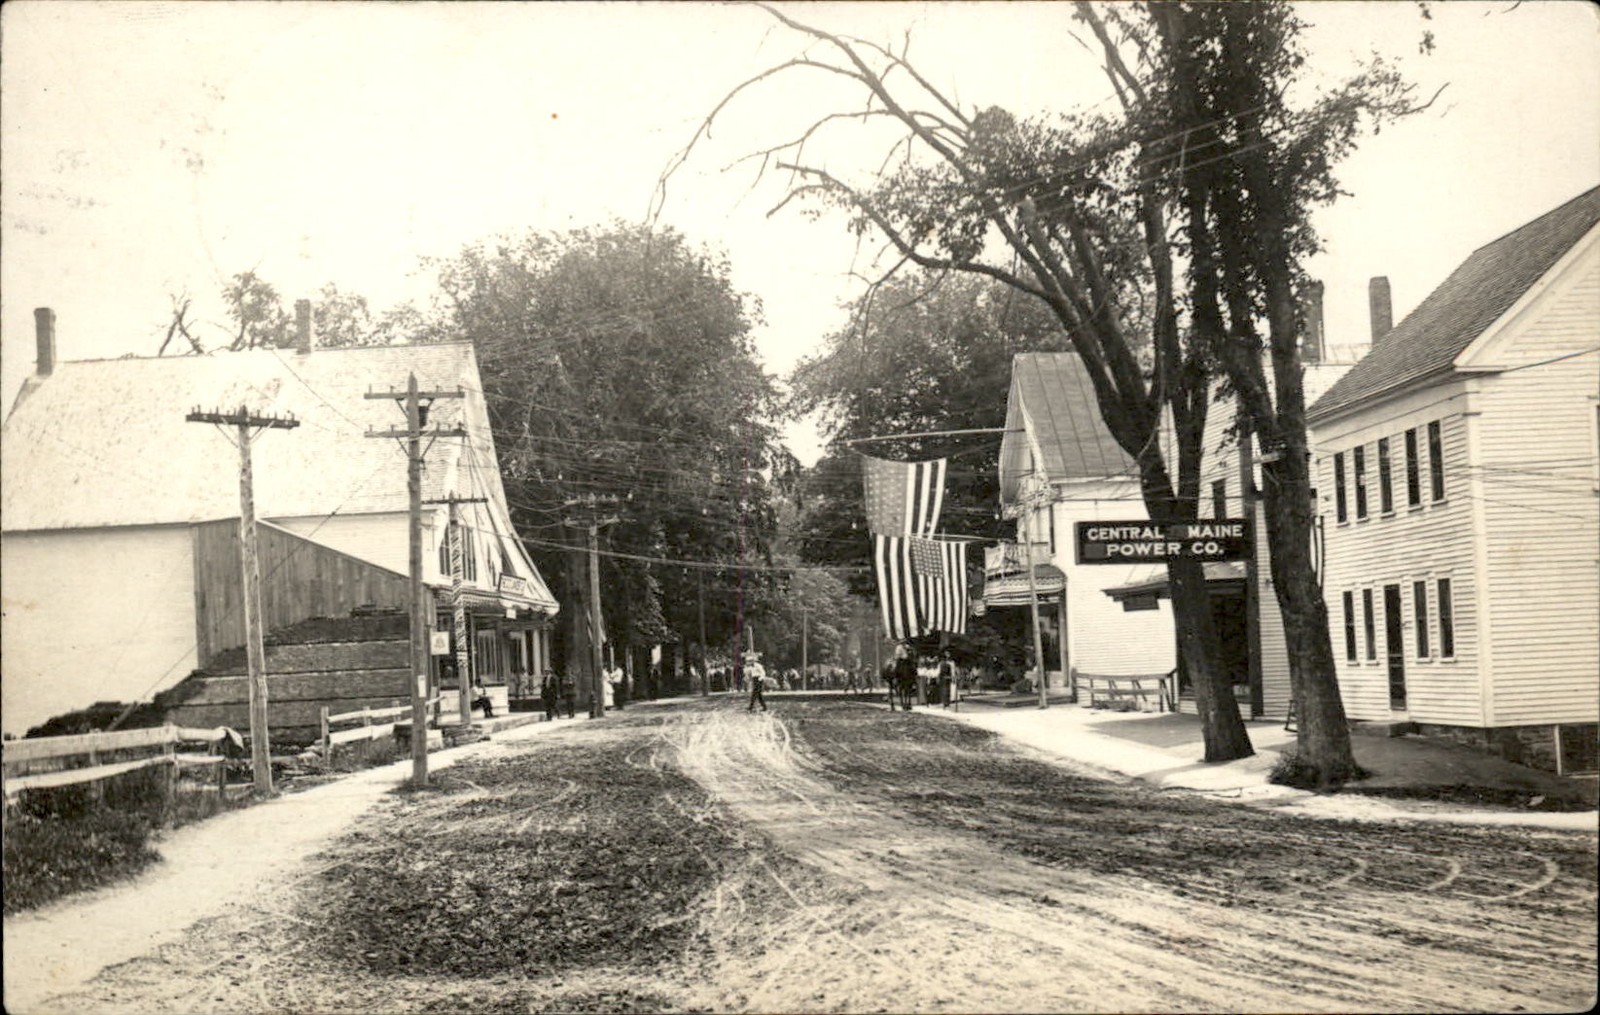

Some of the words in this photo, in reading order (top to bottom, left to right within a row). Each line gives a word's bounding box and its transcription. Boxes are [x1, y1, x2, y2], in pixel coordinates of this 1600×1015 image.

[1087, 526, 1165, 541] CENTRAL
[1187, 525, 1243, 538] MAINE
[1106, 542, 1182, 556] POWER
[1191, 541, 1225, 554] CO.
